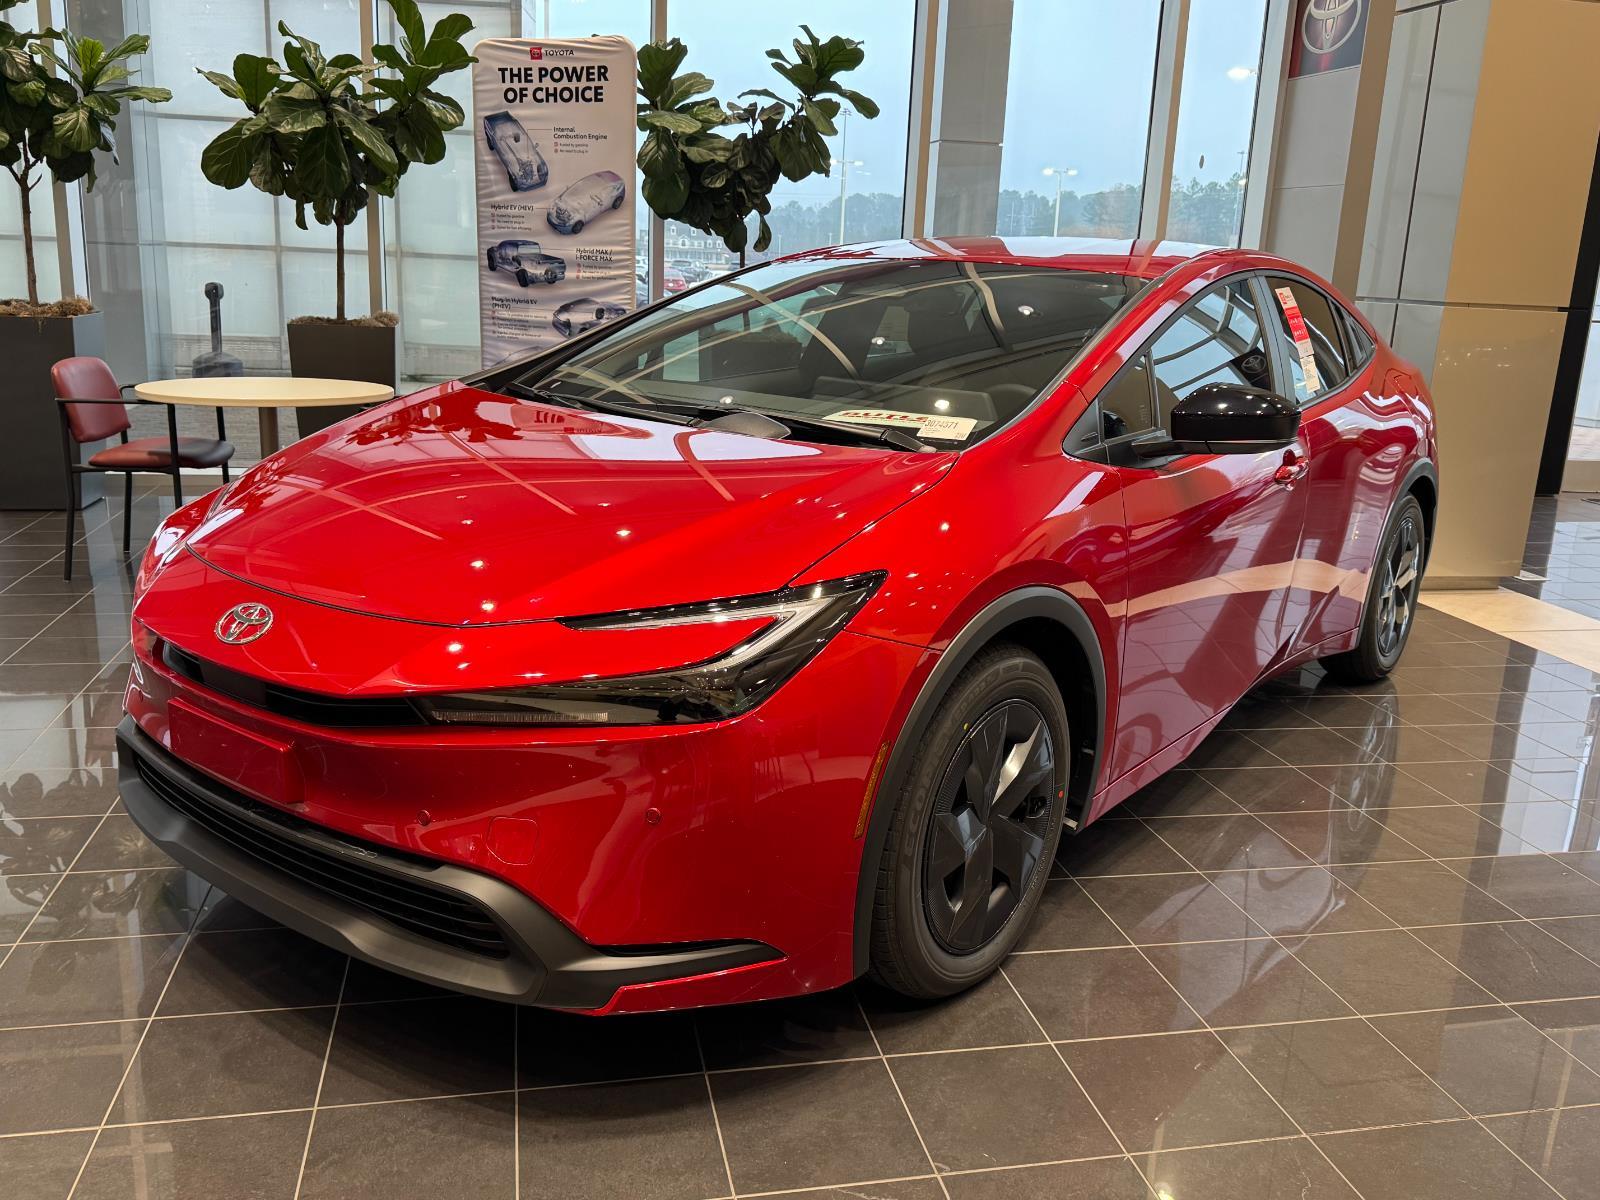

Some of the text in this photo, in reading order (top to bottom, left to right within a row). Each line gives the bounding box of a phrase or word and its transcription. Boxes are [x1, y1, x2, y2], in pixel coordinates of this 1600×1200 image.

[544, 49, 574, 57] TOYOTA
[498, 65, 609, 83] THE POWER
[504, 86, 604, 103] OF CHOICE
[588, 133, 608, 141] Engine
[490, 203, 510, 211] Hybrid
[517, 204, 534, 212] (HEV)
[575, 247, 595, 255] Hybrid
[491, 302, 511, 310] (PHEV)
